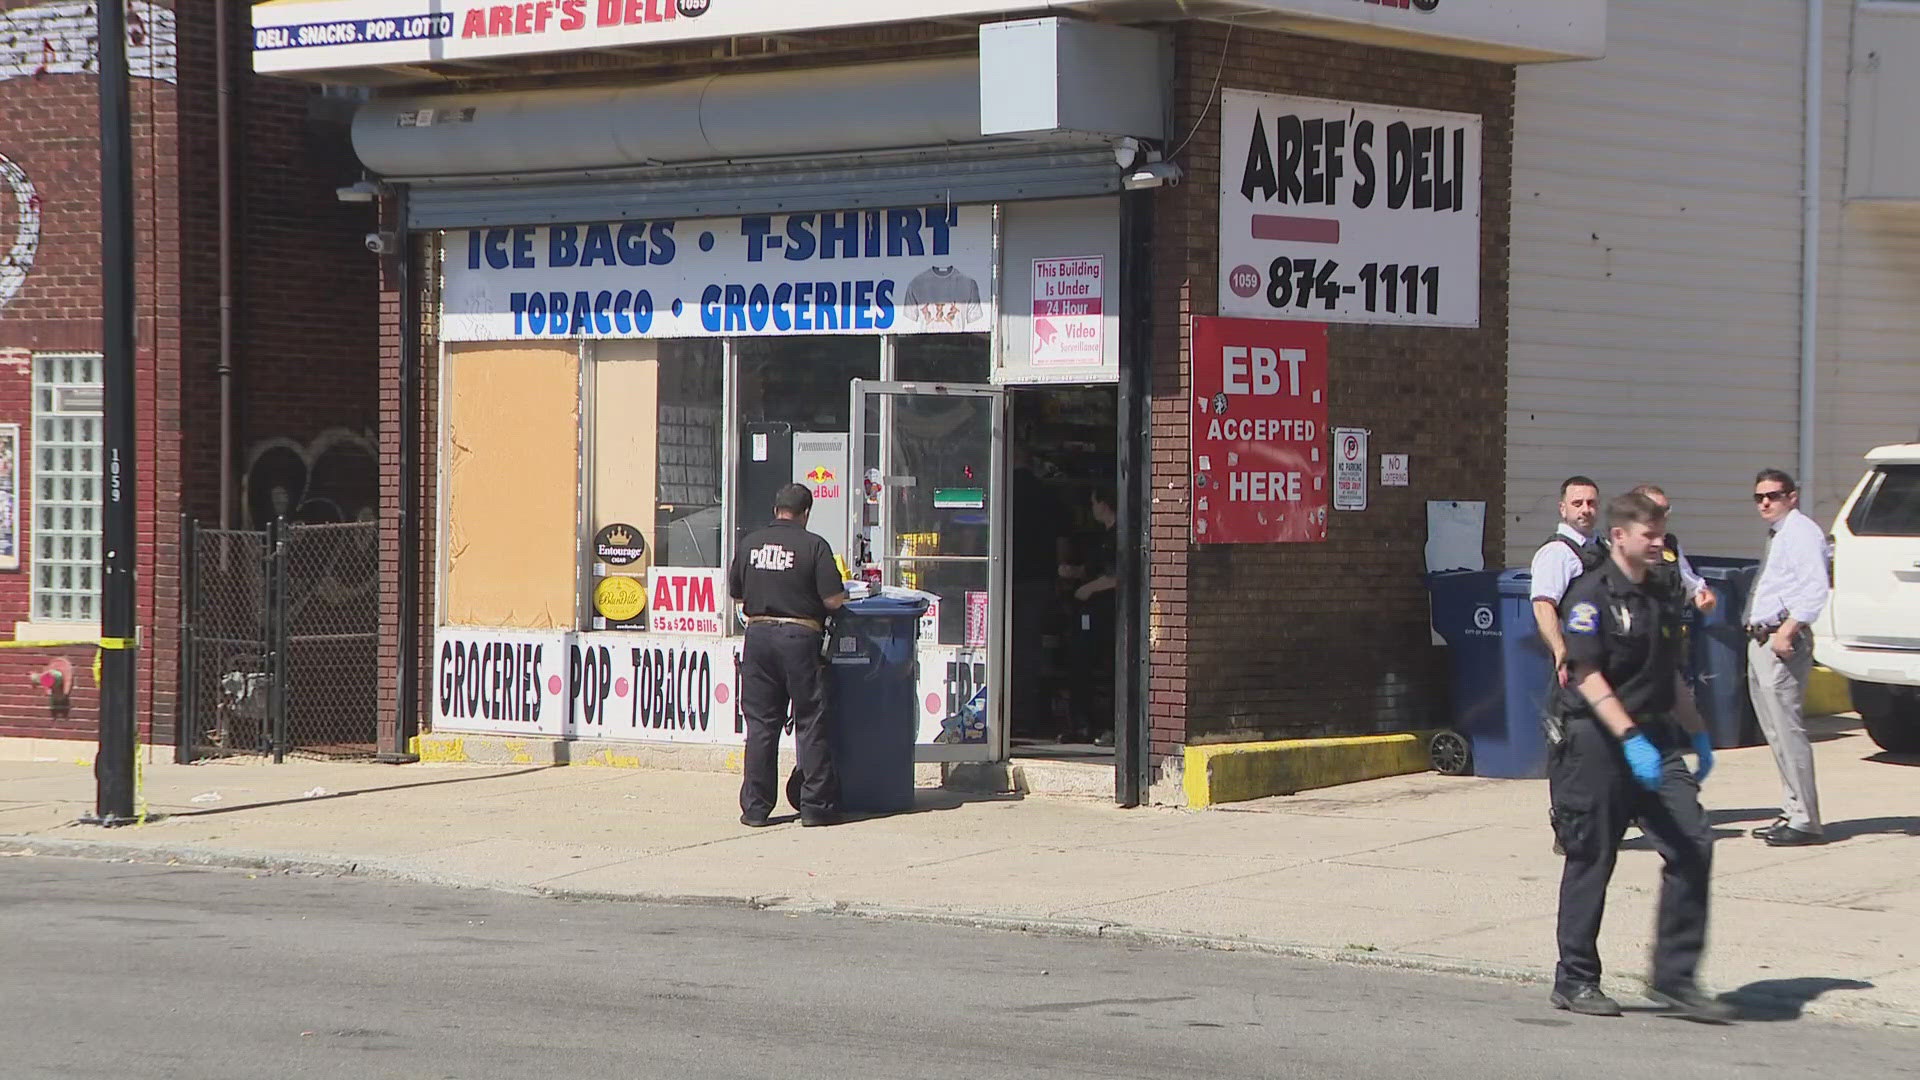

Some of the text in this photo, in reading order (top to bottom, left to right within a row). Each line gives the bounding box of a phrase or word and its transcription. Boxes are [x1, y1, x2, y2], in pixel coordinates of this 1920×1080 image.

[461, 0, 676, 39] AREF'S DELI
[256, 16, 451, 49] DELI SNACKS POP LOTTO
[1240, 106, 1465, 213] AREF'S DELI
[468, 207, 957, 270] ICE BAGS T-SHIRT
[1037, 262, 1100, 278] This Building
[1045, 279, 1090, 297] Is Under
[1232, 255, 1440, 316] 1059 874-1111
[510, 279, 895, 336] TOBACCO GROCERIES
[1046, 300, 1089, 316] 24 Hour
[1065, 322, 1096, 339] Video
[1060, 342, 1099, 353] Surveillance
[1222, 345, 1307, 397] EBT
[1206, 418, 1316, 442] ACCEPTED
[1388, 457, 1401, 471] NO
[821, 485, 839, 498] Bull
[1229, 471, 1302, 502] HERE
[598, 544, 642, 559] Entourage
[750, 549, 795, 568] POLICE
[652, 575, 716, 612] ATM
[654, 617, 666, 630] $5
[674, 617, 695, 631] $20
[697, 619, 717, 633] Bills
[440, 640, 542, 722] GROCERIES
[569, 644, 611, 725] POP
[631, 647, 710, 732] TOBACCO
